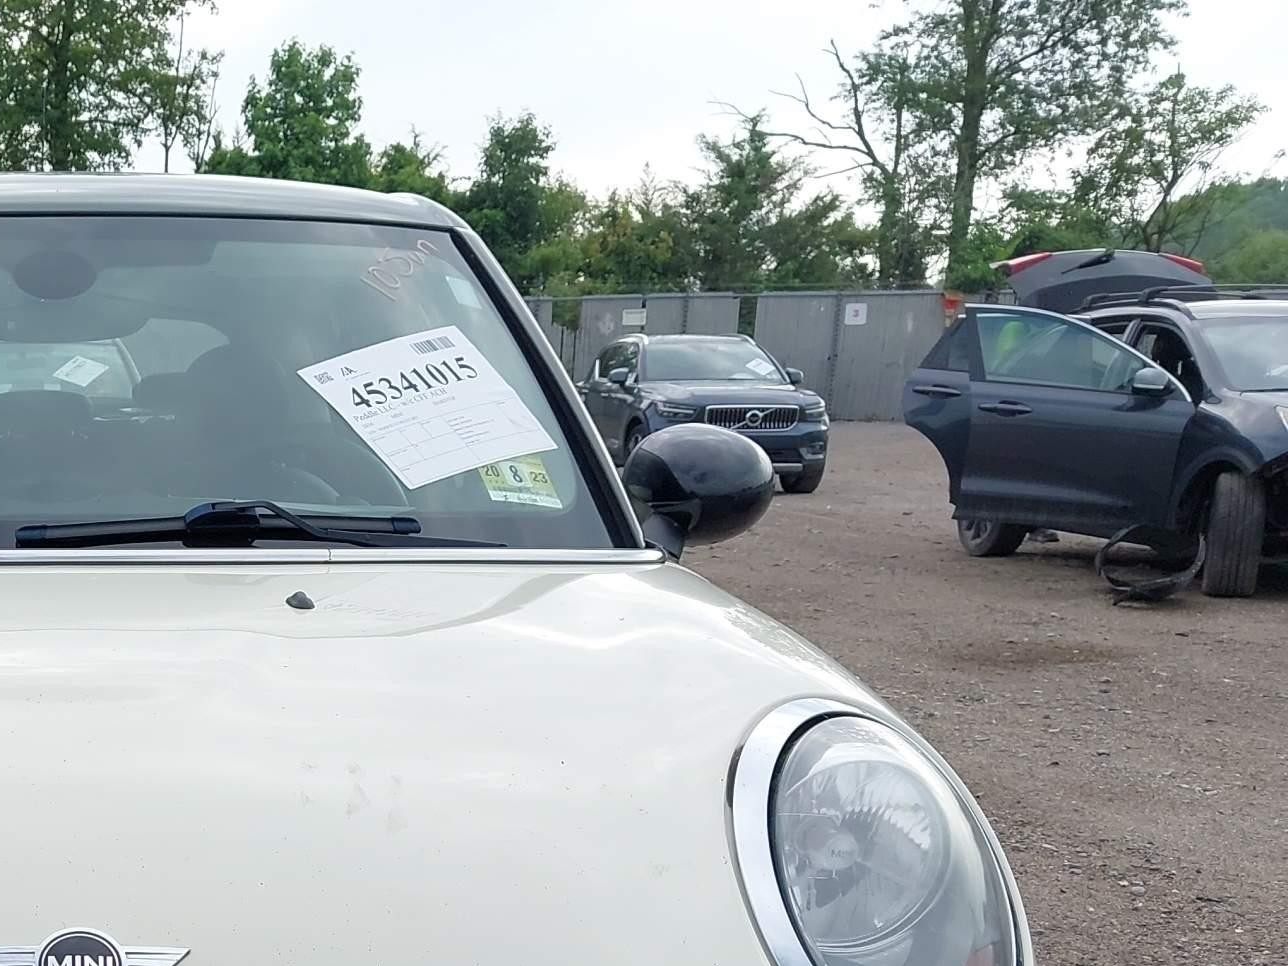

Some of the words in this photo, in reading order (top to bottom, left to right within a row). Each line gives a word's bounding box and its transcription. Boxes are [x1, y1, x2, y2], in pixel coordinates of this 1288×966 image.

[352, 356, 479, 408] 45341015
[485, 465, 500, 477] 20
[509, 464, 523, 483] 8
[530, 471, 548, 484] 23
